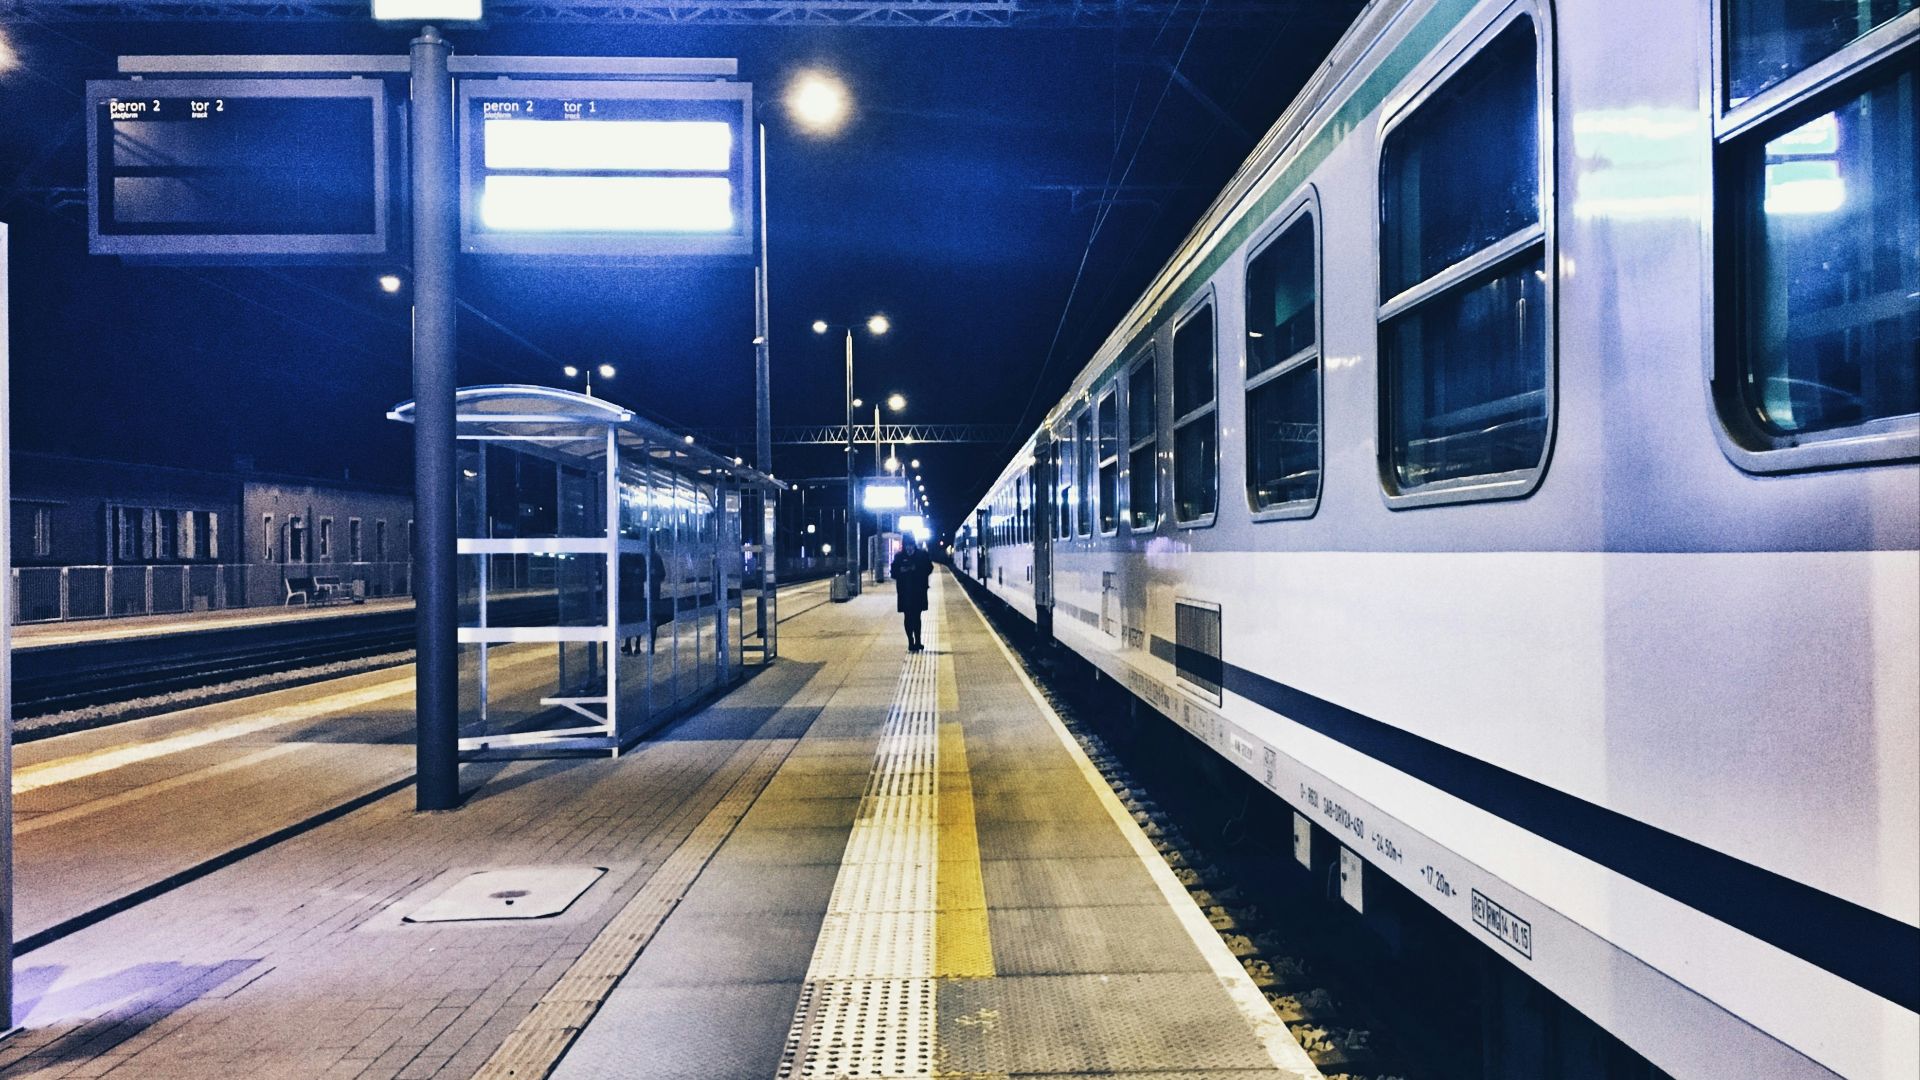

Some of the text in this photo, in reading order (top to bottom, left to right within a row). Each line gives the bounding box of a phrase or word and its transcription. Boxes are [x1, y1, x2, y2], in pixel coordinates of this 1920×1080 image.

[110, 100, 161, 114] peron 2
[190, 100, 224, 112] tor 2
[483, 100, 534, 113] peron 2
[563, 101, 597, 112] tor 1
[1473, 895, 1486, 921] REV
